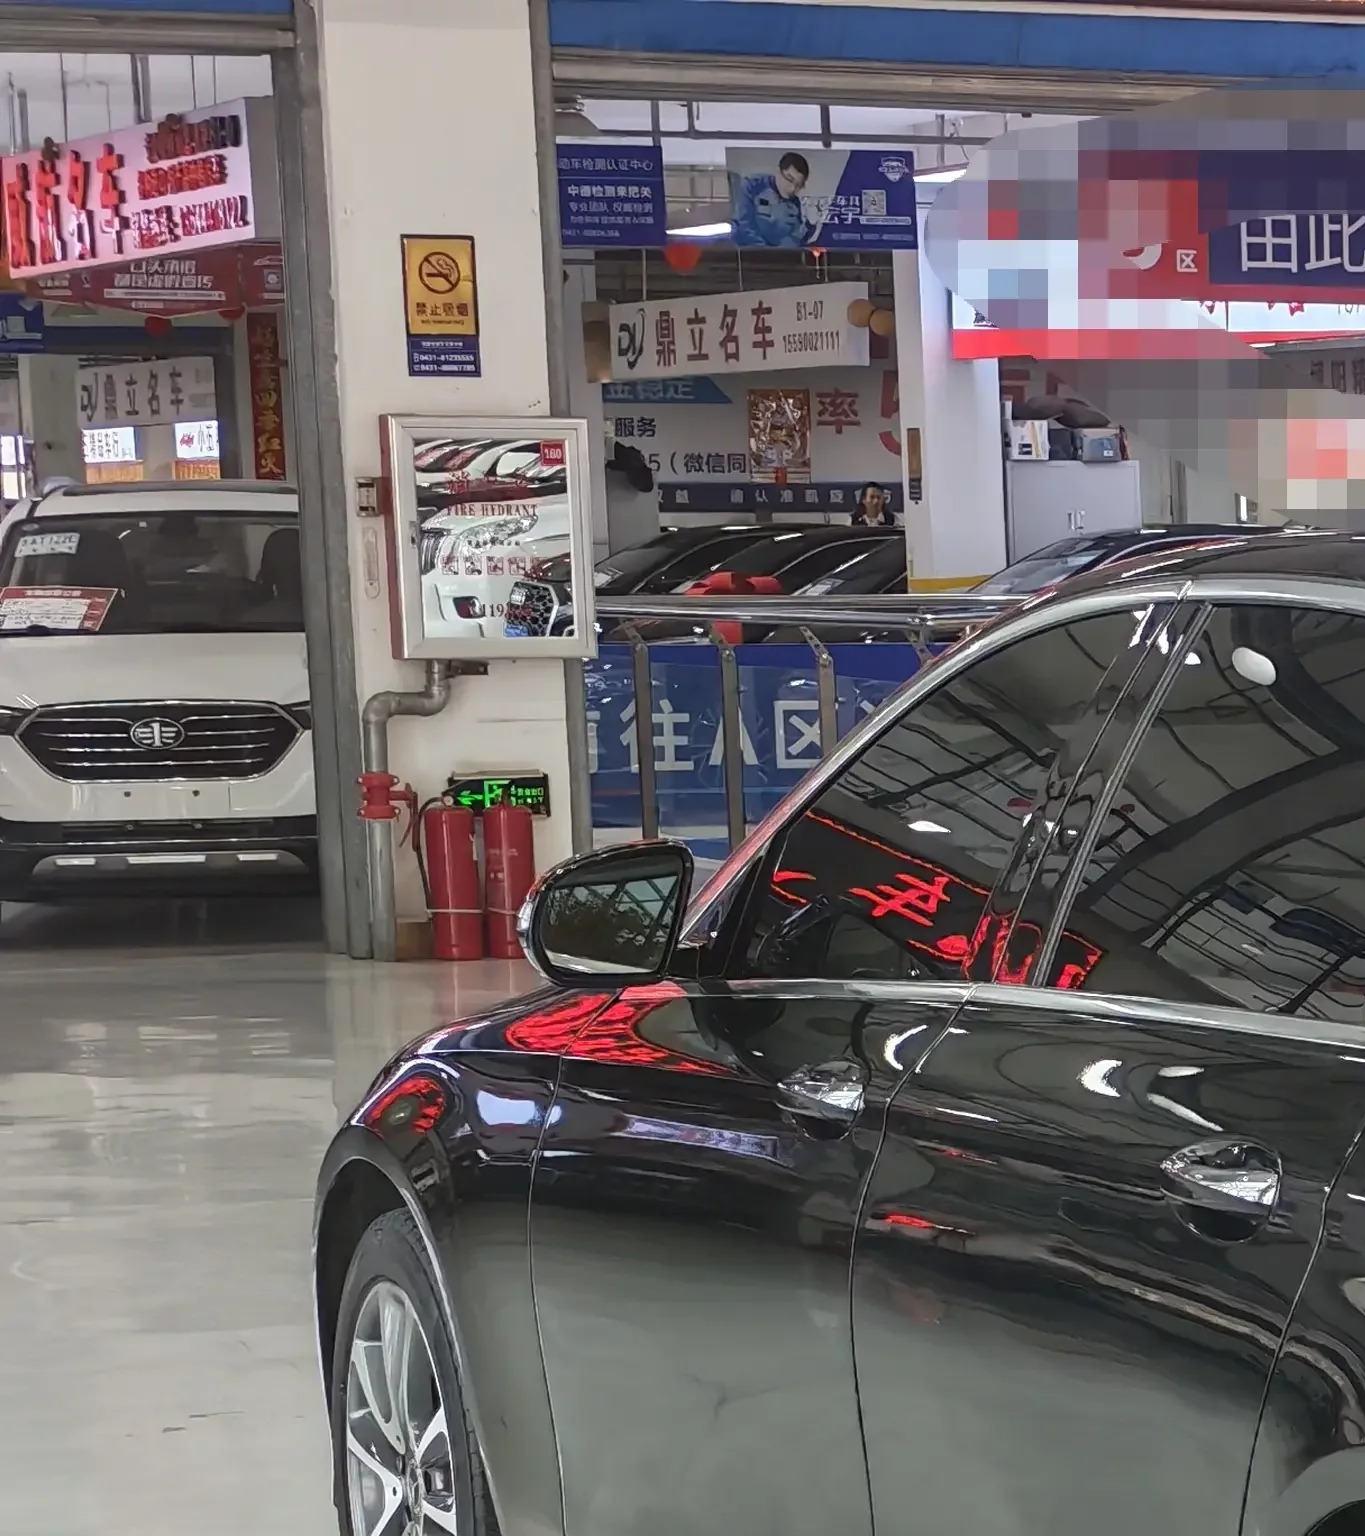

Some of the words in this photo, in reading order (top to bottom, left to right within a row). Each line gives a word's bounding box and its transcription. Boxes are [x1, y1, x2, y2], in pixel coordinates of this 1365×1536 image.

[1176, 249, 1198, 272] 区
[656, 301, 775, 367] 鼎立名车
[615, 417, 656, 437] 服务
[816, 388, 860, 434] 率
[447, 503, 475, 516] FIRE
[481, 503, 538, 516] HYDRANT
[588, 698, 878, 773] 往A区
